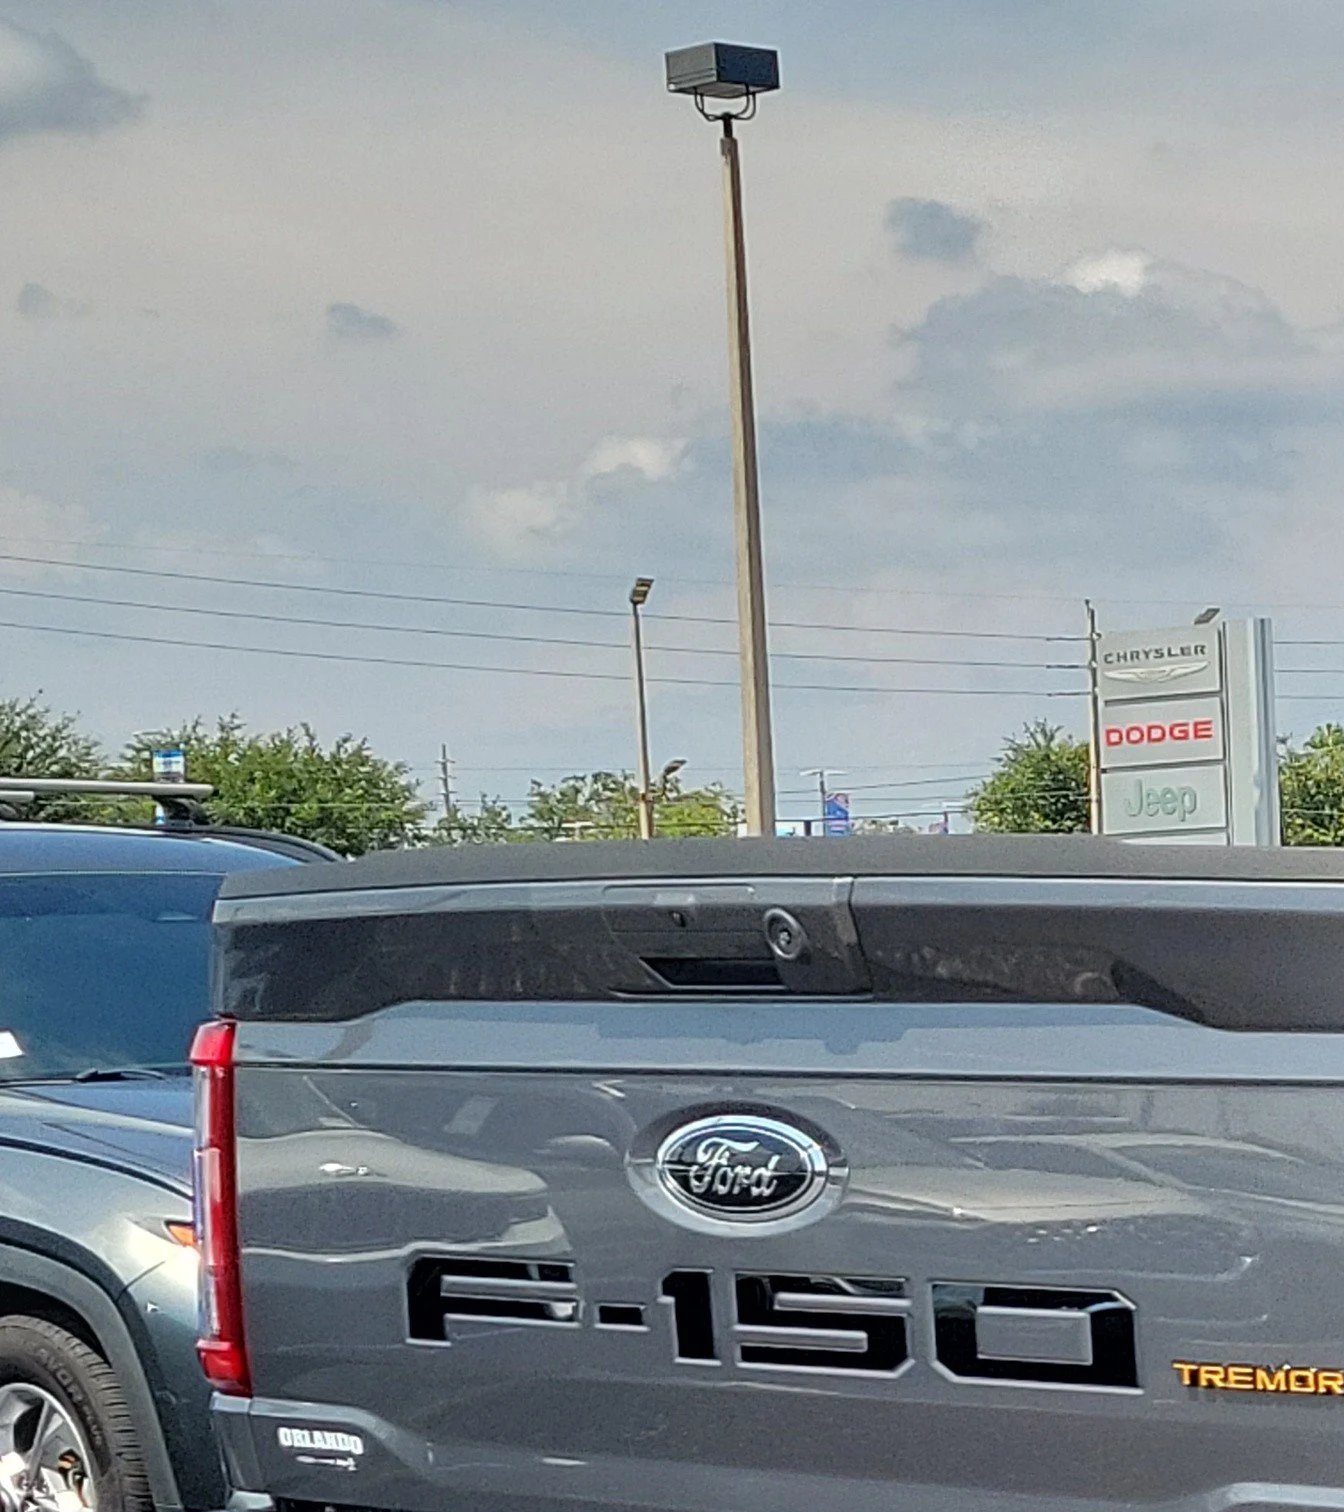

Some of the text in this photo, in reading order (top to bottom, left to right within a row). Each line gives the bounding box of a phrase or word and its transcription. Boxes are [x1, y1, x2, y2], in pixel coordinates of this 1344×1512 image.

[1103, 644, 1206, 665] CHRYSLER
[1104, 719, 1213, 748] DODGE
[1126, 779, 1198, 822] Jeep
[689, 1136, 781, 1197] Ford
[405, 1254, 1145, 1396] F-150
[276, 1426, 364, 1456] ORLANDO
